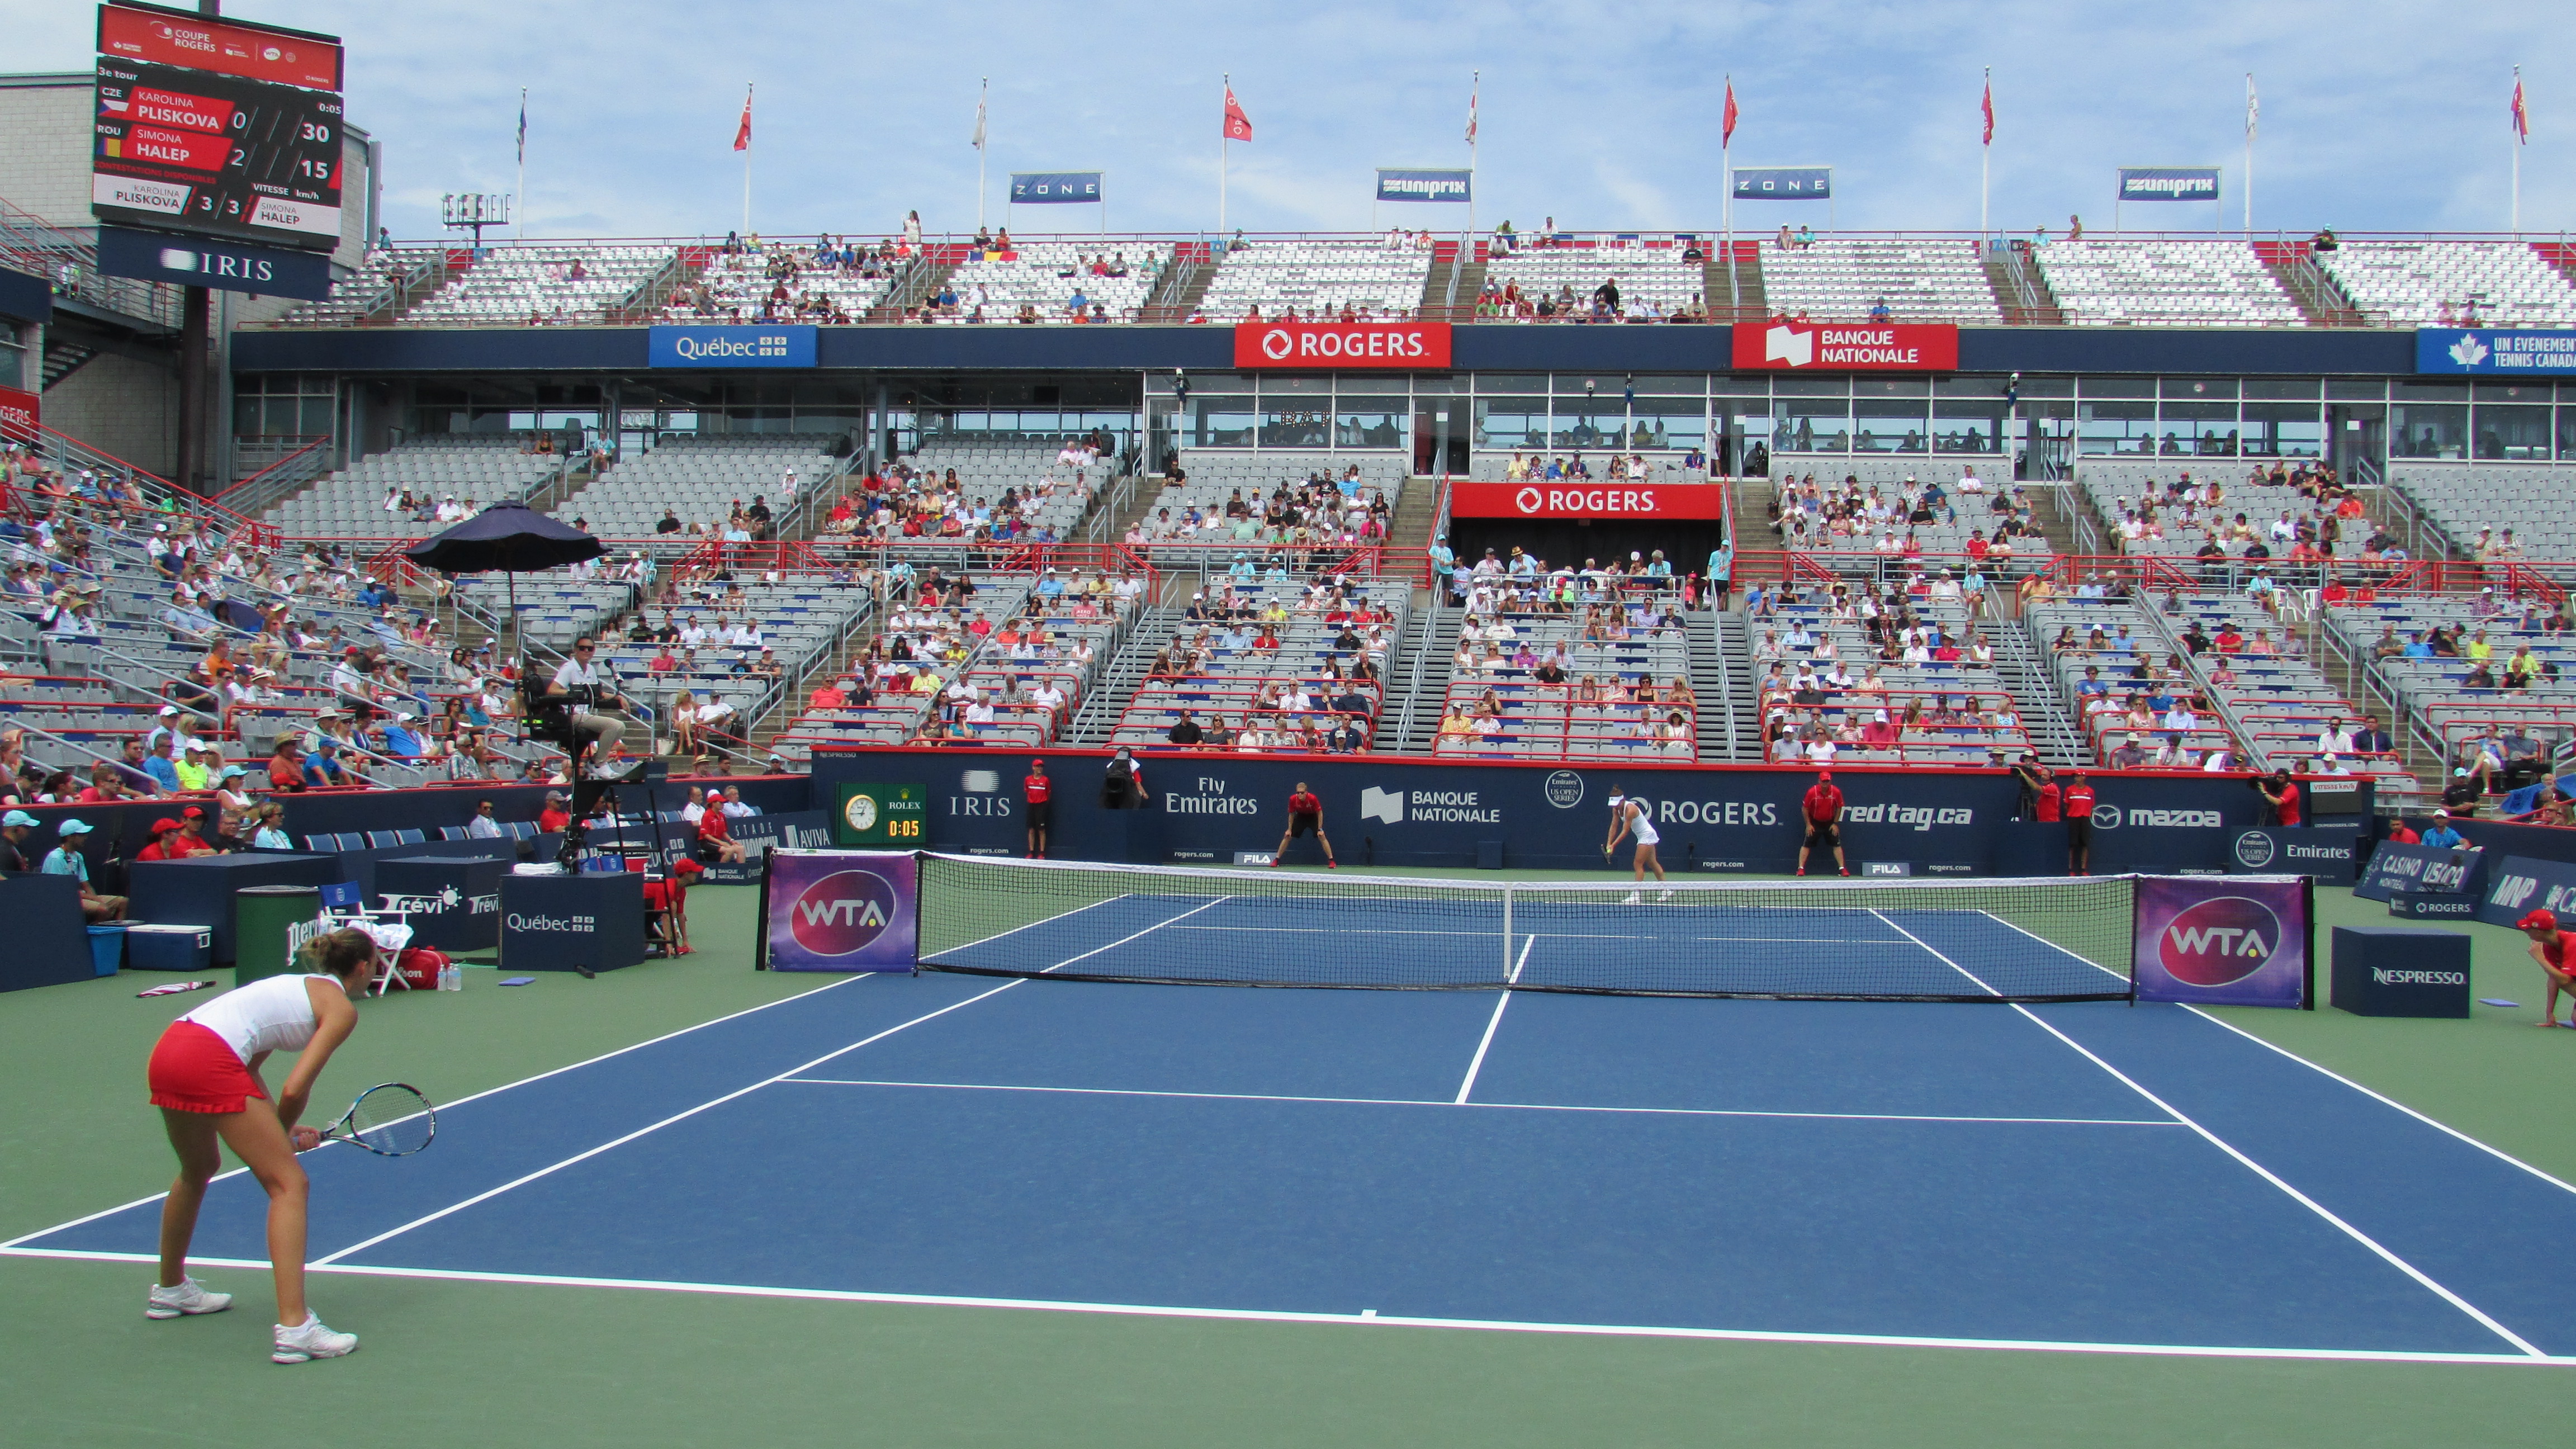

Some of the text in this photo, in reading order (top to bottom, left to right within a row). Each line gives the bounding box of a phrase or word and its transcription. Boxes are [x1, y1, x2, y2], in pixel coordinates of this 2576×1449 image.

[175, 29, 210, 42] COUPE
[174, 38, 216, 52] ROGERS
[98, 67, 138, 80] 3e tour
[102, 87, 122, 97] CZE
[138, 91, 193, 108] KAROLINA
[138, 105, 220, 129] PLISKOVA
[319, 103, 342, 115] 0:05
[233, 112, 247, 129] 0
[97, 125, 121, 136] ROU
[136, 129, 182, 144] SIMONA
[302, 124, 330, 143] 30
[136, 143, 190, 162] HALEP
[231, 149, 245, 166] 2
[94, 161, 216, 184] CONTESTATIONS DISPONIBLES
[301, 160, 329, 179] 15
[134, 184, 180, 197] KAROLINA
[253, 183, 319, 200] VITESSE km/h
[1016, 184, 1096, 195] ZONE
[1401, 180, 1466, 199] uniprix
[1739, 181, 1825, 191] ZONE
[2144, 179, 2213, 197] uniprix
[116, 191, 180, 209] PLISKOVA
[200, 196, 212, 211] 3
[228, 200, 240, 215] 3
[261, 202, 297, 214] SIMONA
[261, 212, 300, 225] HALEP
[201, 253, 274, 281] IRIS
[1301, 333, 1423, 357] ROGERS
[1821, 330, 1894, 345] BANQUE
[2494, 337, 2576, 352] UN ÉVÉNEMEN
[676, 337, 755, 360] Québec
[1821, 348, 1919, 363] NATIONALE
[2493, 353, 2533, 367] TENNIS
[1549, 490, 1655, 512] ROGERS
[1199, 778, 1225, 795] Fly
[950, 797, 1010, 817] IRIS
[1166, 793, 1258, 815] Emirates
[1412, 791, 1478, 806] BANQUE
[1412, 808, 1501, 823] NATIONALE
[1660, 801, 1777, 826] ROGERS
[735, 822, 773, 836] STADE
[889, 820, 920, 836] 0:05
[800, 828, 831, 848] AVIVA
[1243, 855, 1271, 863] FILA
[2286, 844, 2350, 859] Emirates
[1872, 865, 1901, 874] FILA
[1929, 864, 1971, 872] rogers.com
[2383, 855, 2423, 877] CASINO
[2490, 874, 2537, 908] MNP
[378, 894, 442, 913] Trévi
[468, 894, 499, 914] Trévi
[2428, 903, 2471, 912] ROGERS
[800, 900, 886, 926] WTA
[508, 913, 570, 932] Québec
[2170, 926, 2269, 957] WTA
[2372, 967, 2464, 985] NESPRESSO
